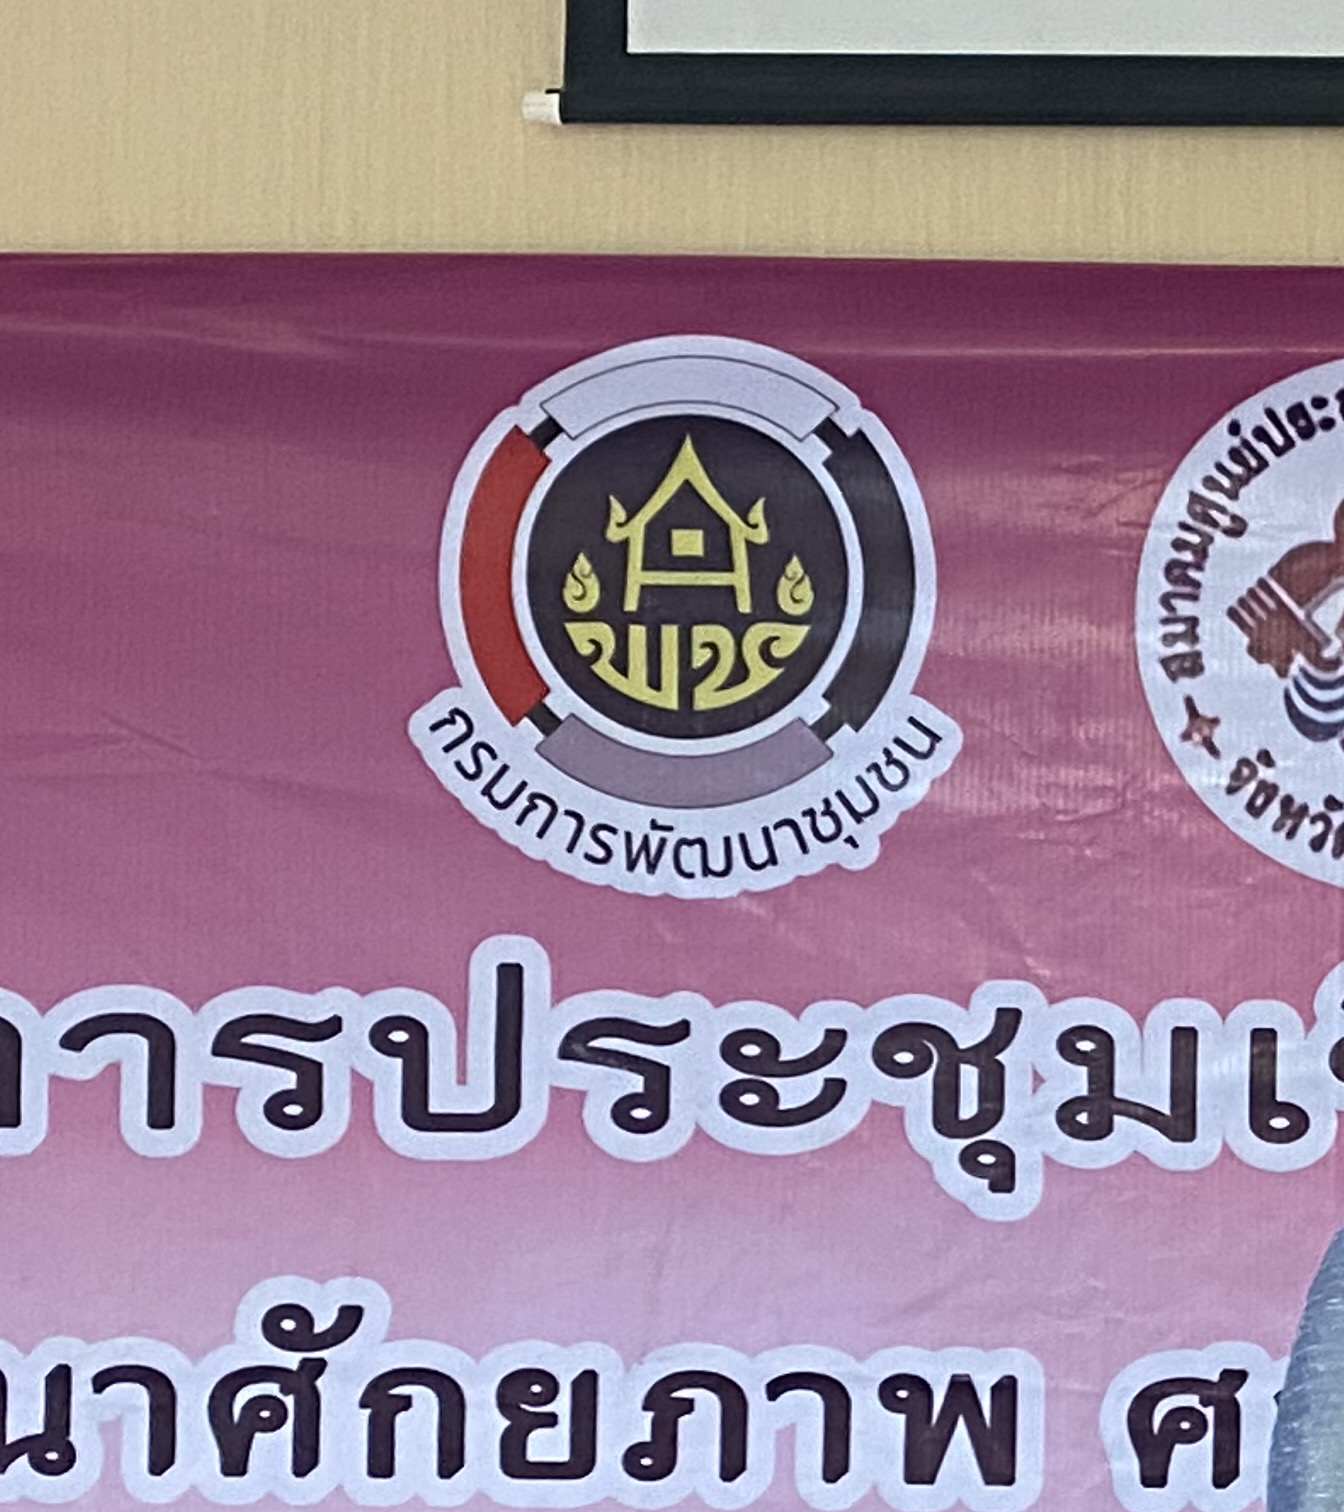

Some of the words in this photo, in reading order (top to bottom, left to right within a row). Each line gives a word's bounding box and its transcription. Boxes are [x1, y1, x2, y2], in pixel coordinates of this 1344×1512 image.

[430, 705, 942, 879] กรมการพัฒนาชุมชน
